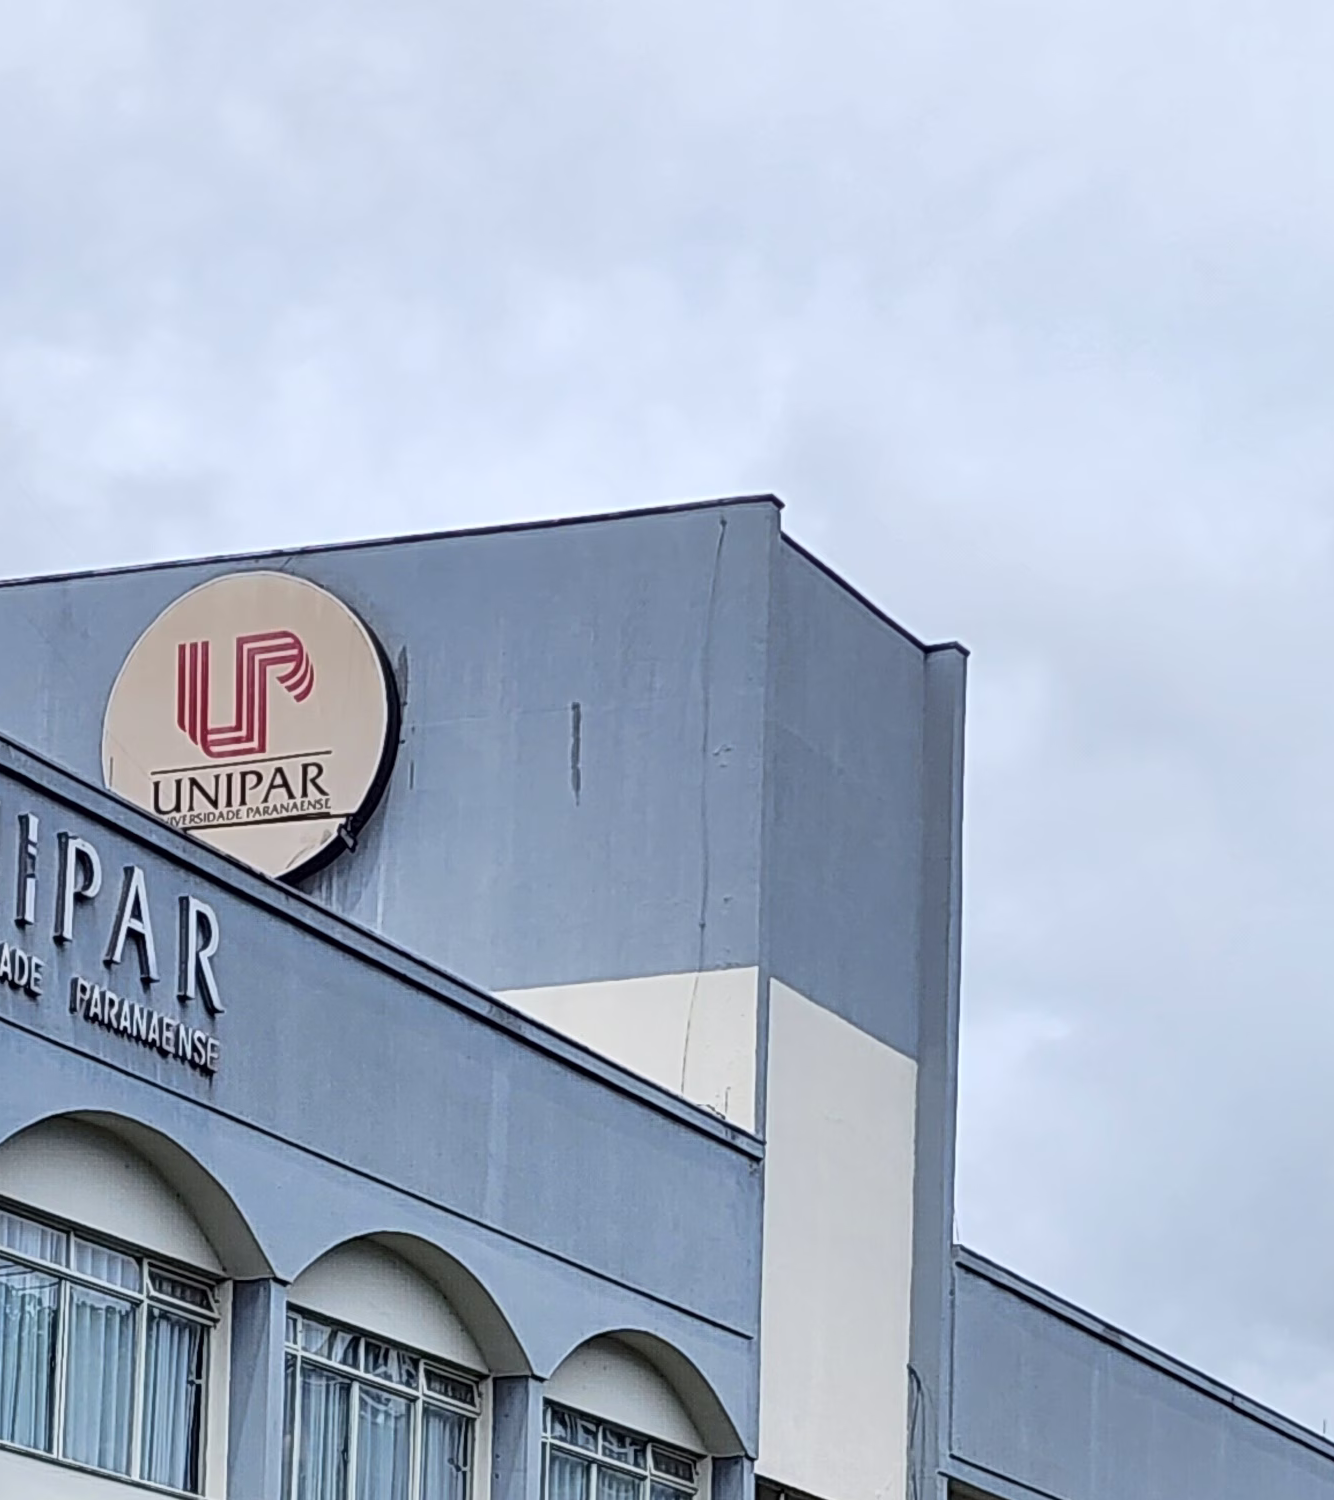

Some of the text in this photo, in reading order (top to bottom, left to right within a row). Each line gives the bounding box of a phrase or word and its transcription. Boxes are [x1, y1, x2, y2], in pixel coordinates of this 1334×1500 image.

[152, 762, 330, 815] UNIPAR
[168, 798, 331, 828] IVERSIDADE PARANAENSE
[70, 976, 220, 1073] PARANAENSE
